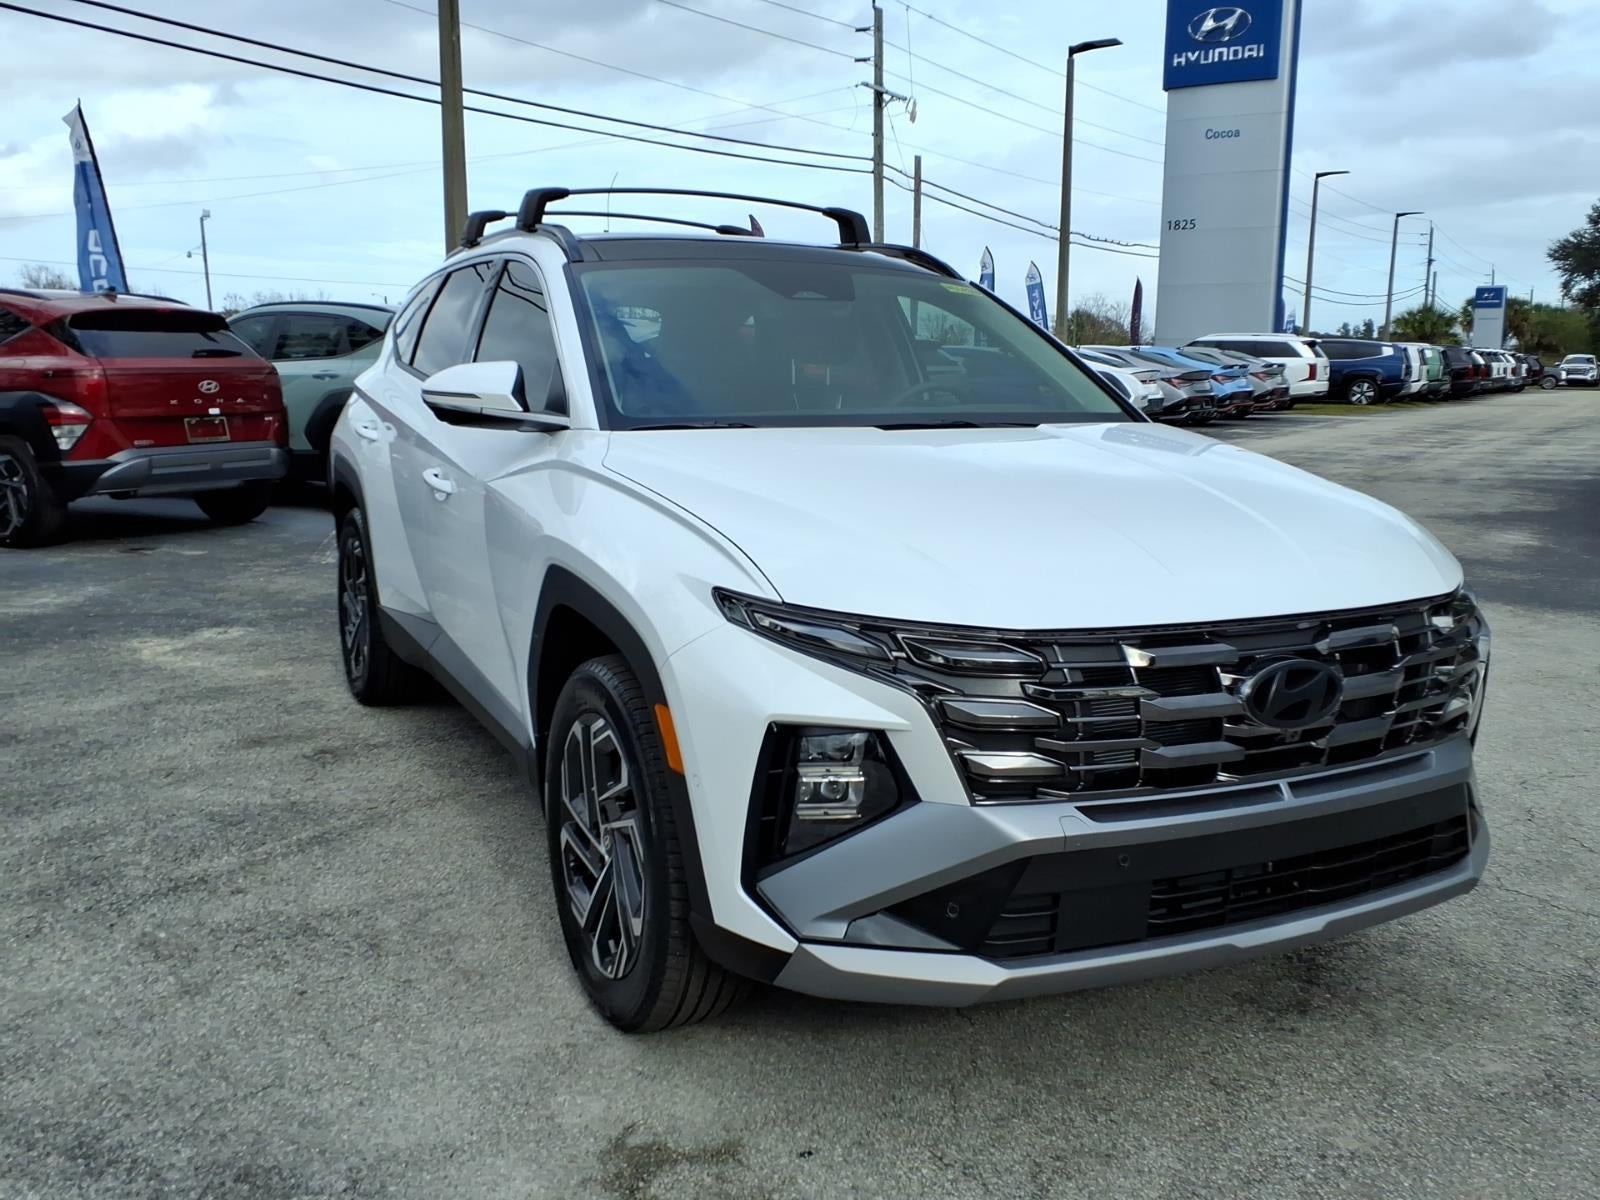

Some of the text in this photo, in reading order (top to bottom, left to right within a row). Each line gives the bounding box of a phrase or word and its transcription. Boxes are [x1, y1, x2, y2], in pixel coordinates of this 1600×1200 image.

[1173, 44, 1265, 67] HYUNDAI
[1205, 128, 1241, 140] Cocoa
[1167, 219, 1197, 231] 1825
